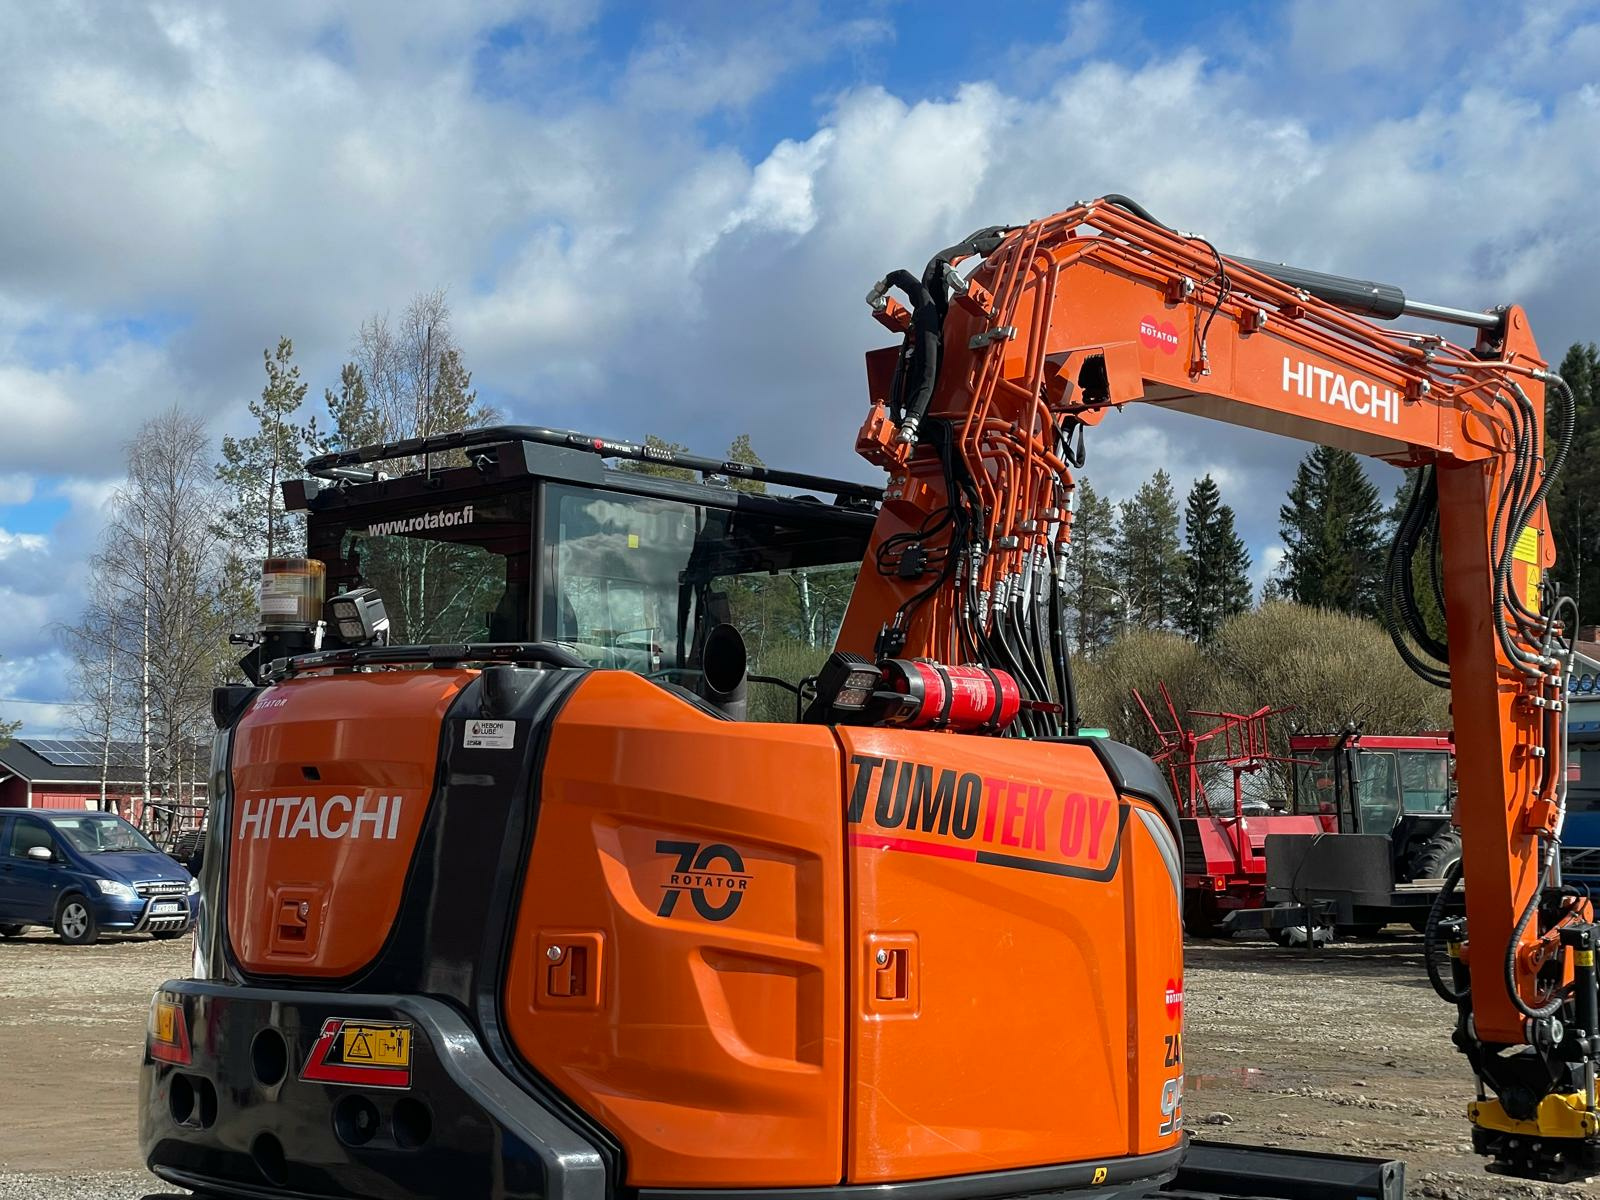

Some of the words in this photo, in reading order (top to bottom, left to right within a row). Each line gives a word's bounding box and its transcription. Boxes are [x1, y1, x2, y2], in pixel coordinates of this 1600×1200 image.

[1140, 325, 1178, 345] ROTATOR
[1282, 356, 1399, 425] HITACHI
[368, 505, 473, 537] www.rotator.fi
[238, 795, 403, 840] HITACHI
[848, 754, 1053, 851] TUMOTEK
[1059, 792, 1112, 861] OY
[655, 840, 745, 922] 70
[670, 874, 747, 890] ROTATOR
